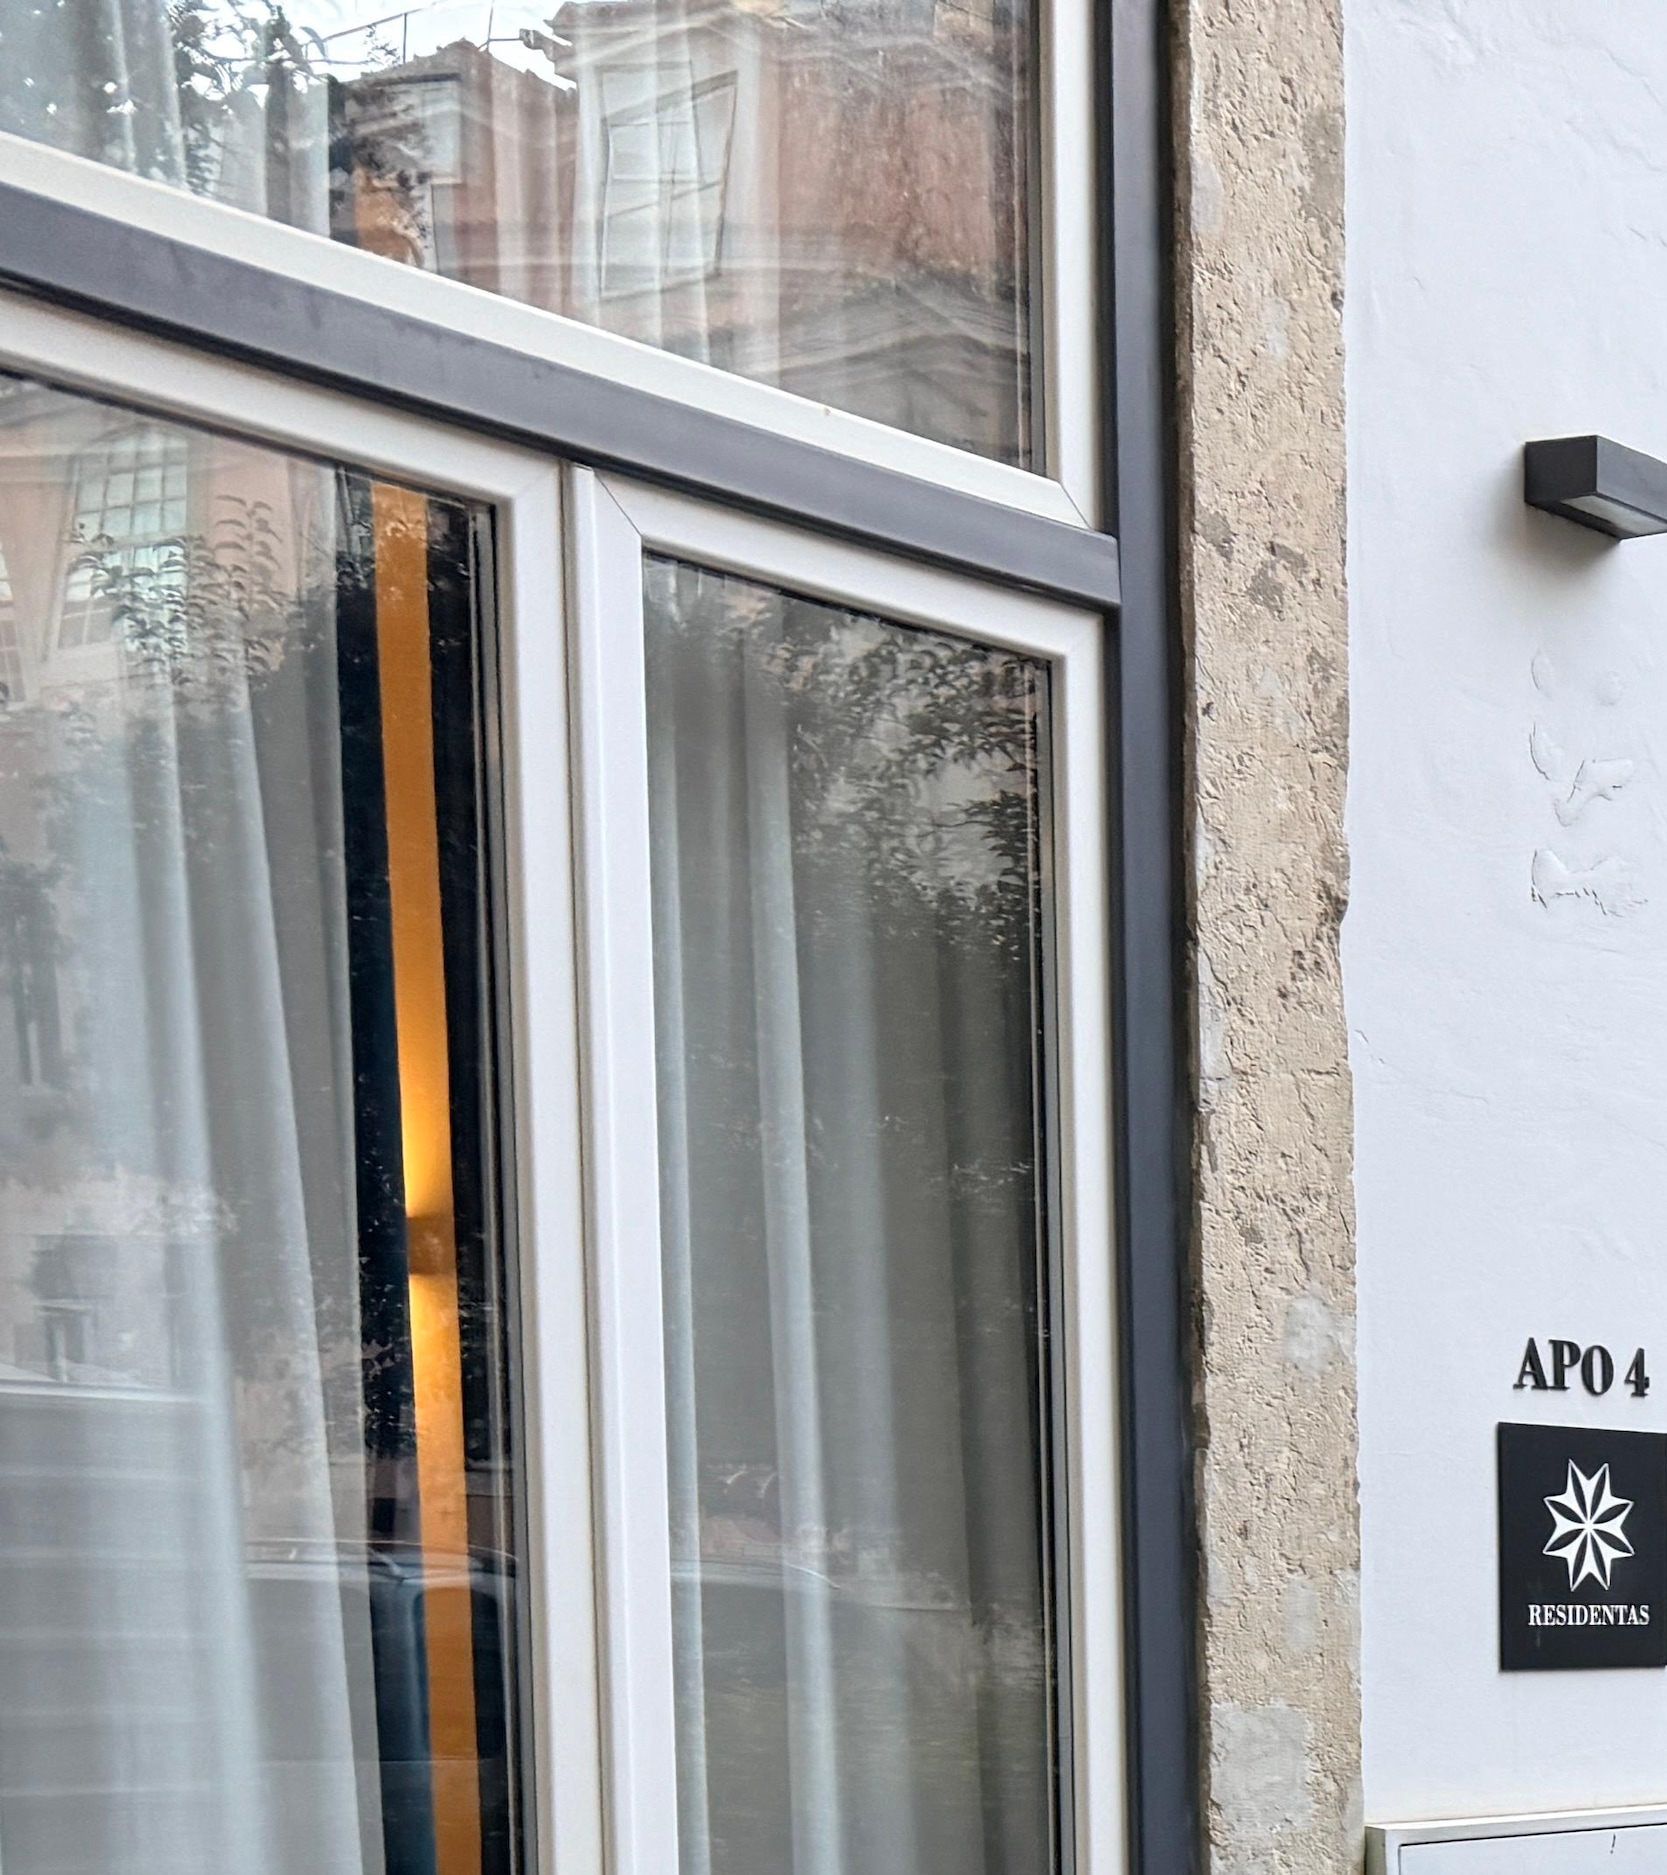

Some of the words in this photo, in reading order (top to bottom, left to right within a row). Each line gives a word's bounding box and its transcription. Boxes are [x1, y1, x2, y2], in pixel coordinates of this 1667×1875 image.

[1512, 1336, 1615, 1397] APO
[1623, 1347, 1650, 1398] 4
[1527, 1604, 1650, 1626] RESIDENTAS
